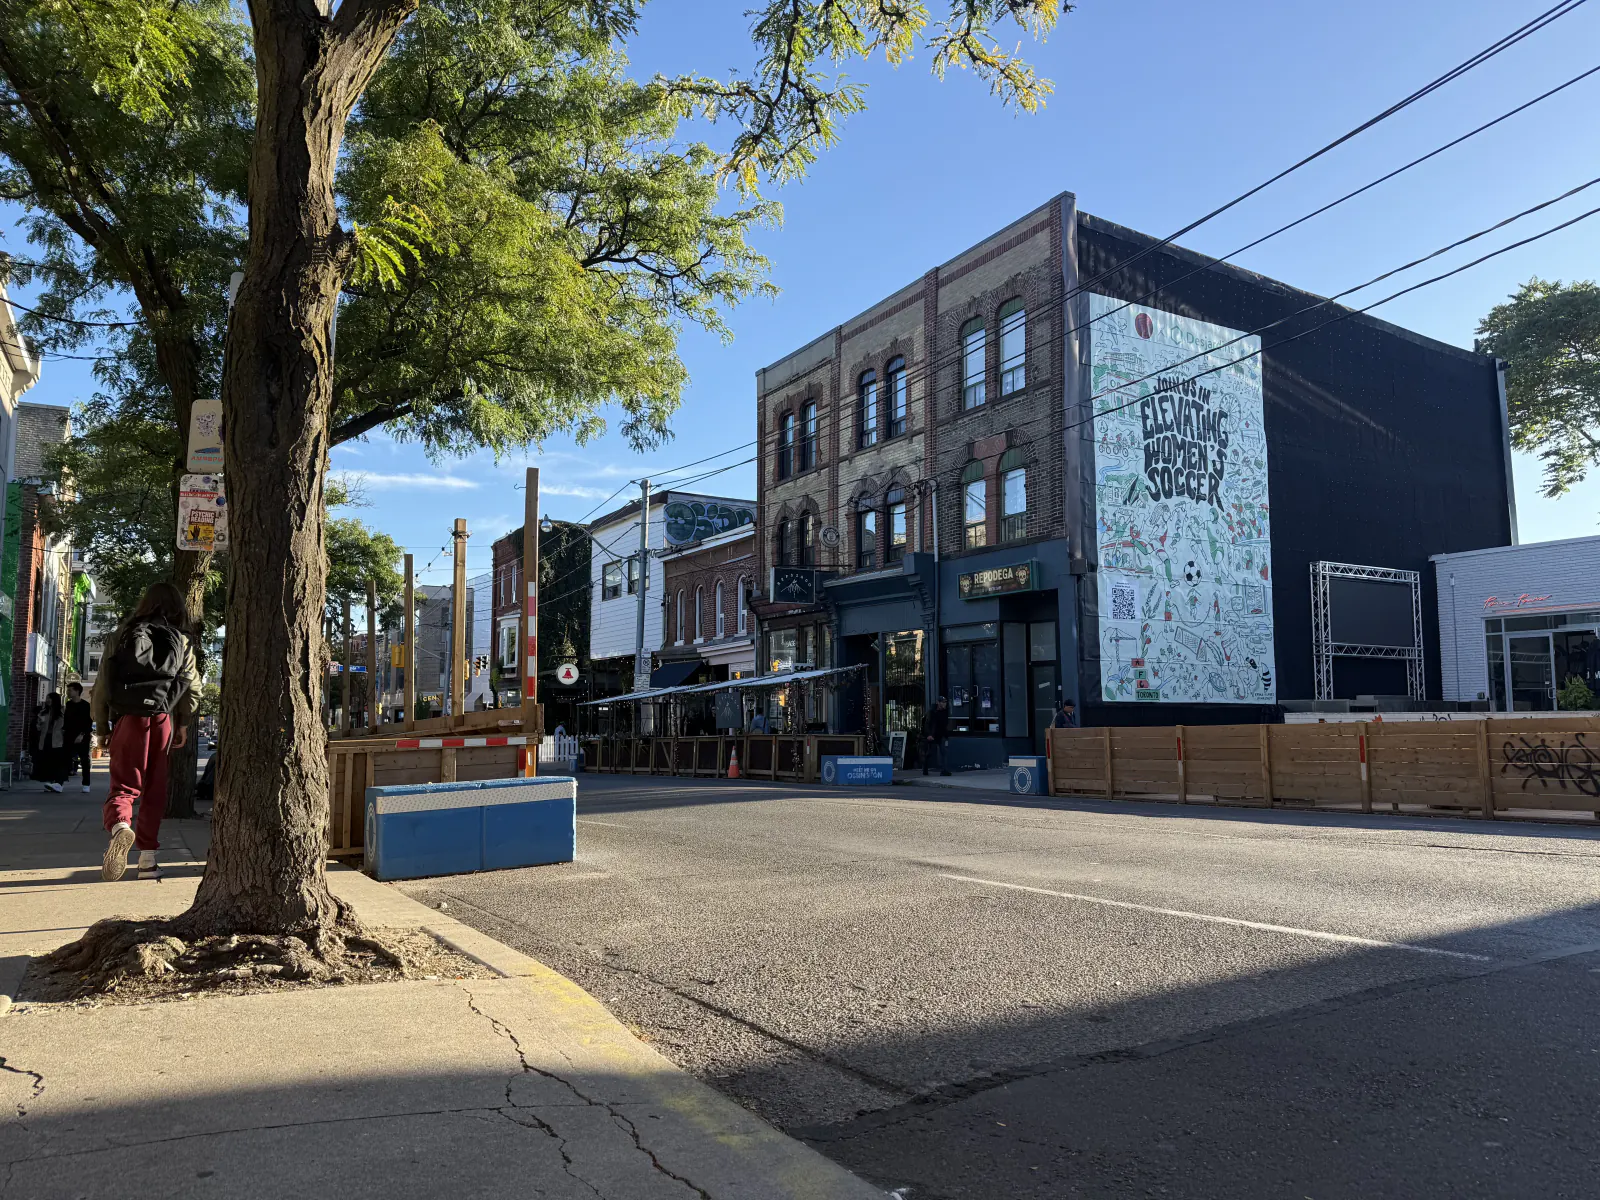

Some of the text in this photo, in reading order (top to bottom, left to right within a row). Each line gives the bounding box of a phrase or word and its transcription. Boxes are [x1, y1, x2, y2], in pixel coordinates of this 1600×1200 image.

[1154, 376, 1180, 394] JOIN
[1182, 378, 1197, 398] US
[1198, 386, 1211, 405] IN
[1140, 395, 1229, 449] ELEVATING
[1144, 434, 1228, 481] WOMEN'S
[1145, 465, 1225, 512] SOCCER
[974, 568, 1014, 584] REPODEGA
[1136, 691, 1159, 699] TORONTO
